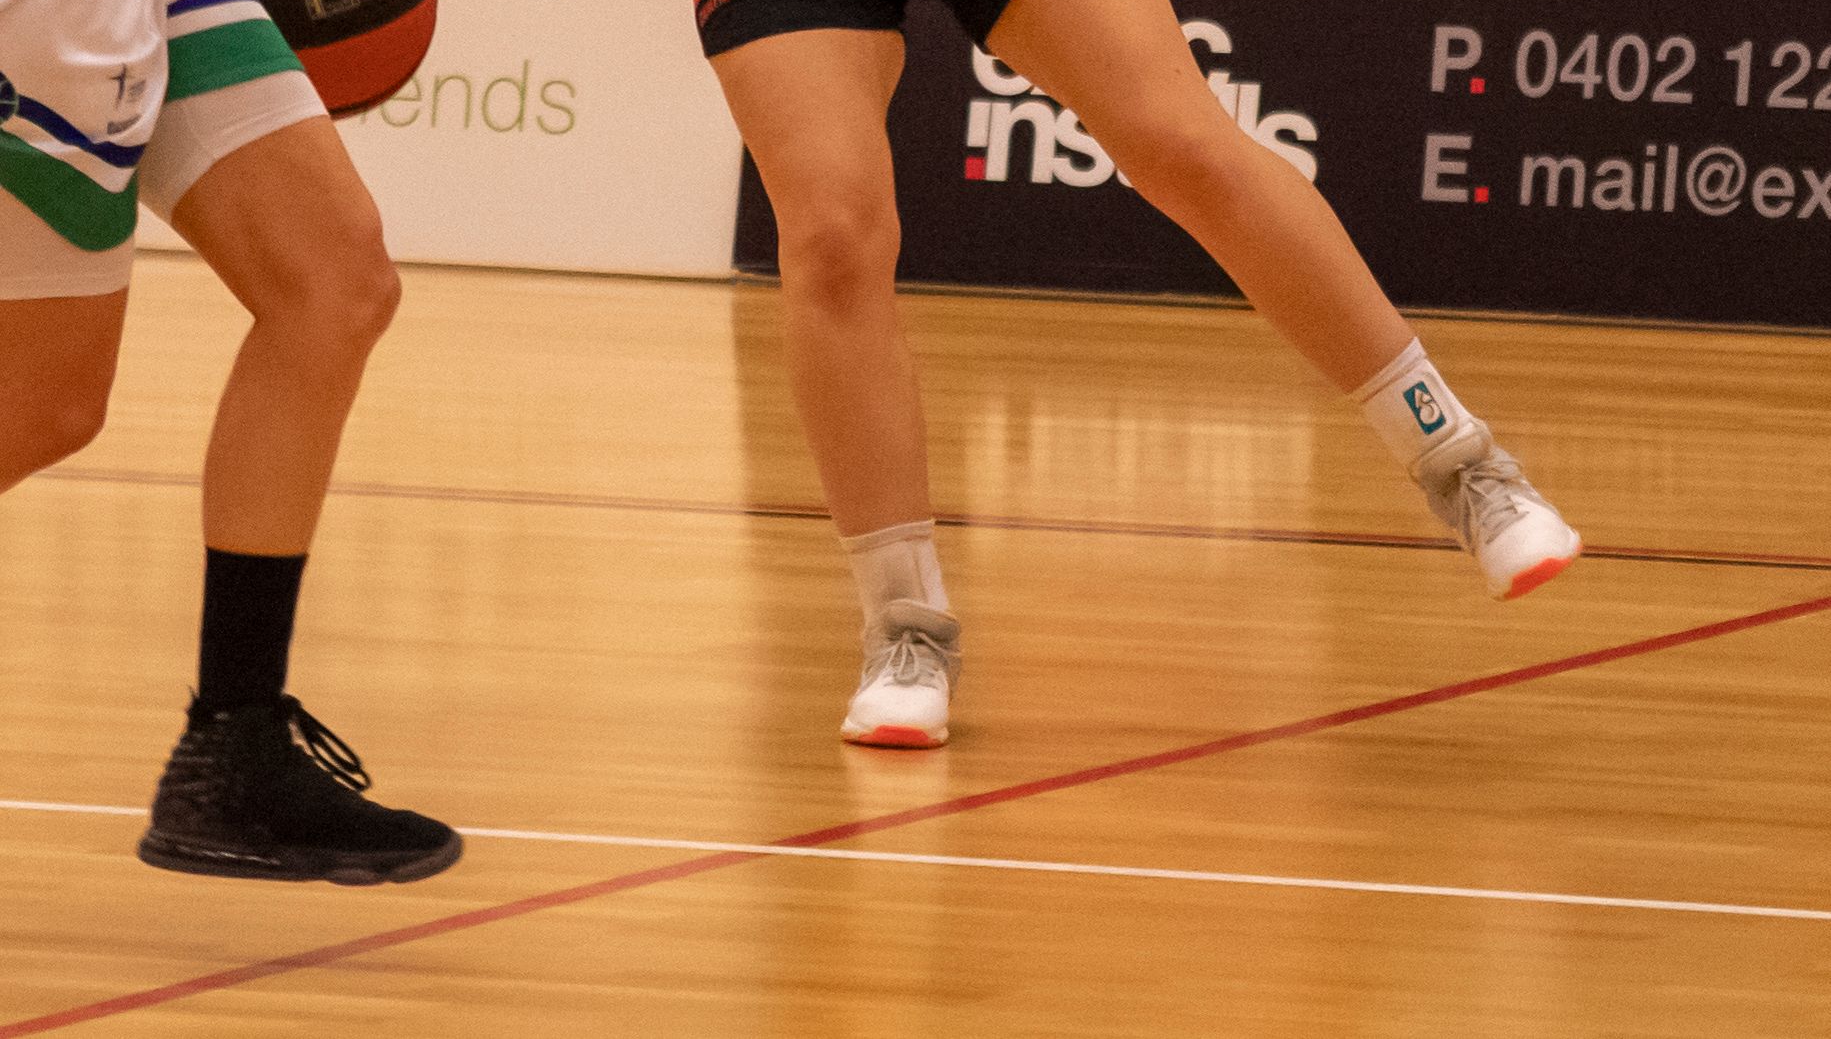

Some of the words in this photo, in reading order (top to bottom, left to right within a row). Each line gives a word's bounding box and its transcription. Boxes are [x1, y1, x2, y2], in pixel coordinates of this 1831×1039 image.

[1430, 25, 1486, 95] P.
[1513, 29, 1697, 105] 0402
[1421, 133, 1490, 203] E.
[1518, 142, 1831, 220] mail@ex
